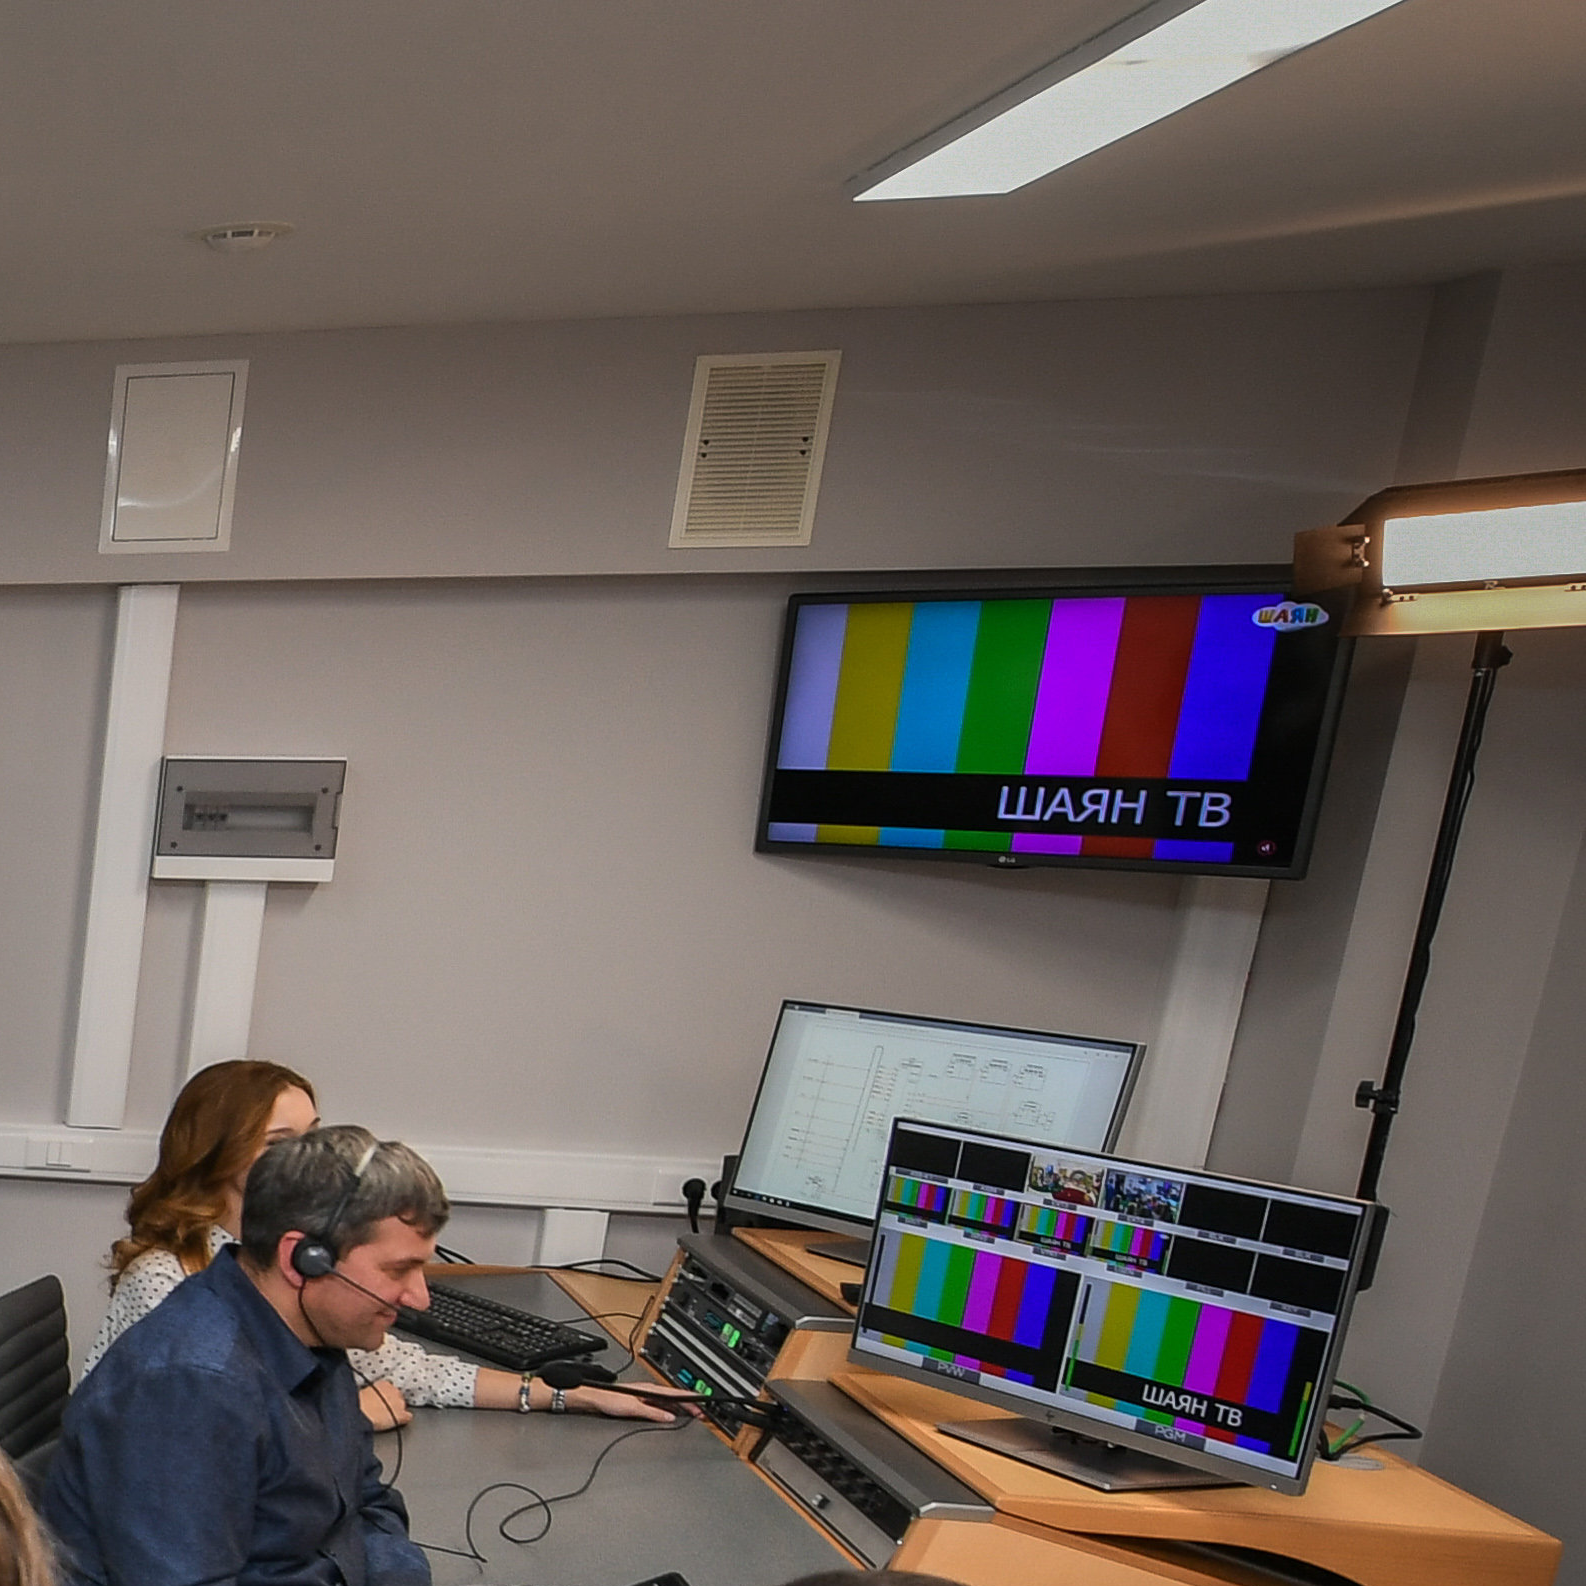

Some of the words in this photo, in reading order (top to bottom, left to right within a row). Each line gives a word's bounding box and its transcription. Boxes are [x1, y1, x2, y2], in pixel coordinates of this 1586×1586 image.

[1255, 604, 1320, 627] ШАЯН
[997, 785, 1147, 825] ШАЯН
[1166, 790, 1233, 828] ТВ
[937, 1362, 966, 1378] PVW
[1142, 1384, 1209, 1418] ШАЯН
[1214, 1403, 1244, 1428] ТВ
[1154, 1425, 1187, 1443] PGM
